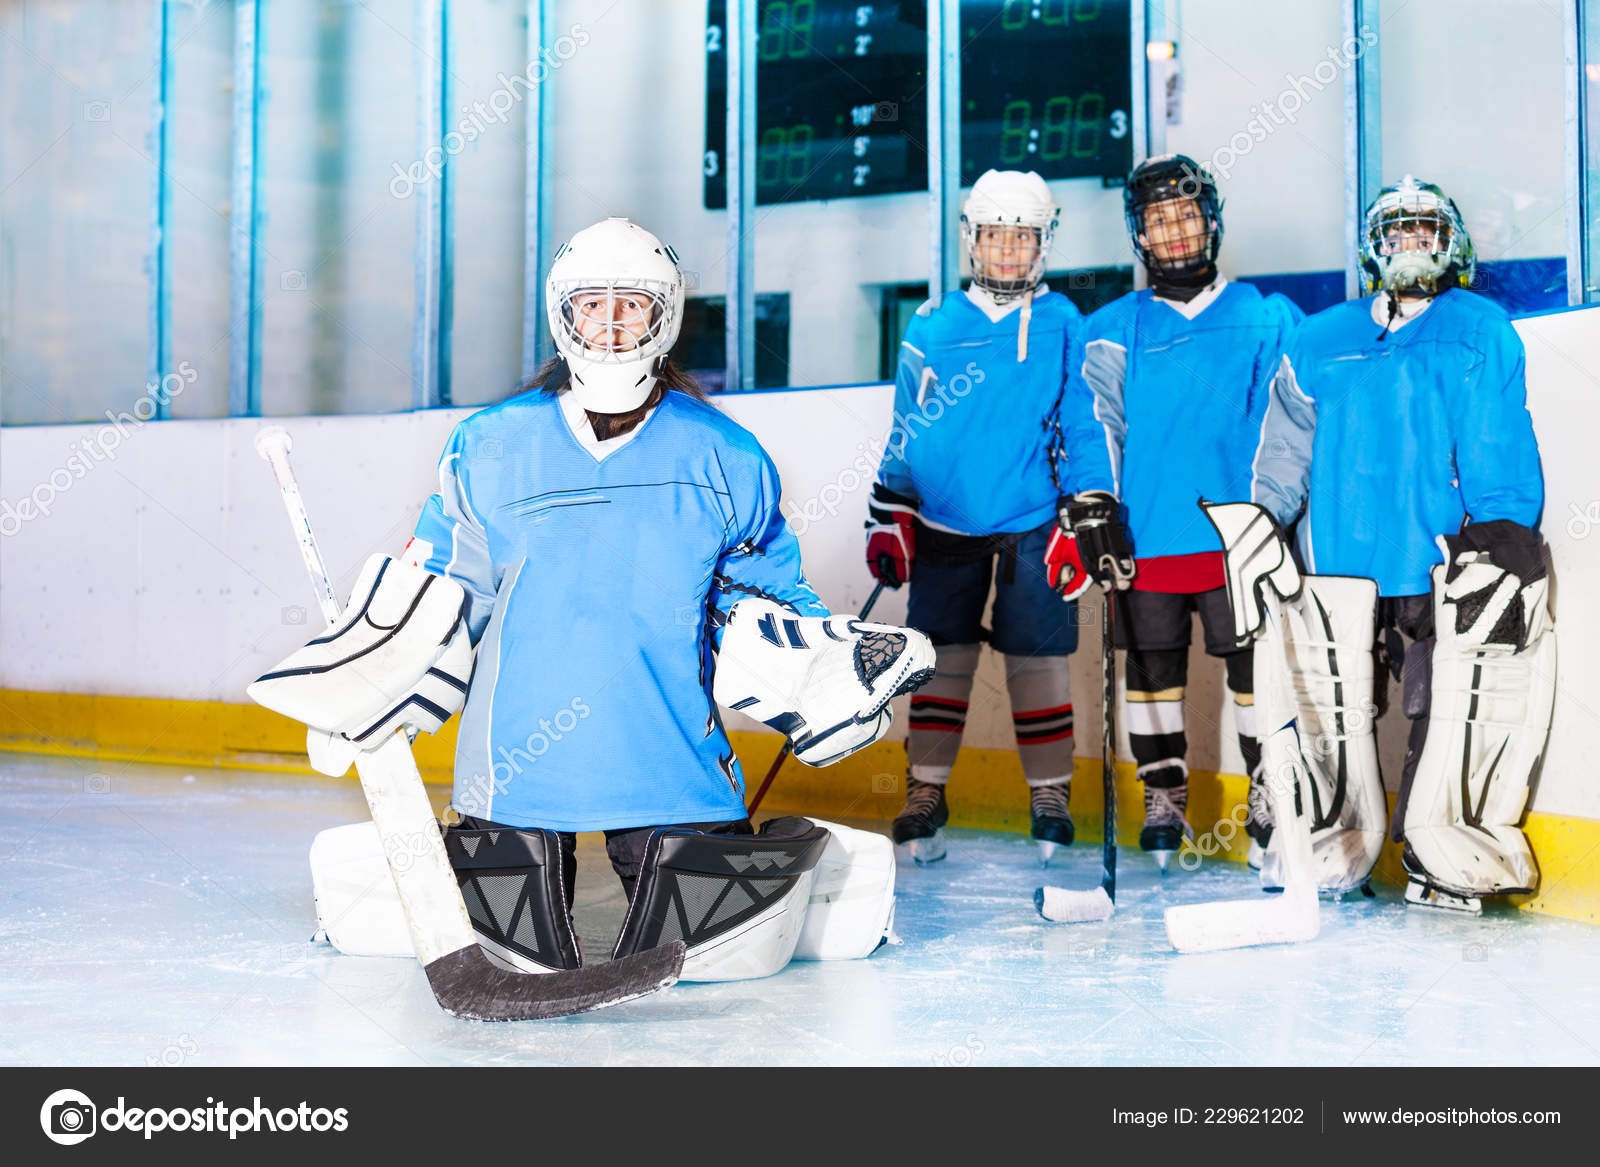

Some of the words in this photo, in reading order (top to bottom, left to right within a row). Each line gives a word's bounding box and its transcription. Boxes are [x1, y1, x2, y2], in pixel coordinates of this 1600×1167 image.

[706, 25, 722, 52] 2
[1109, 109, 1128, 139] 3
[704, 150, 720, 177] 3
